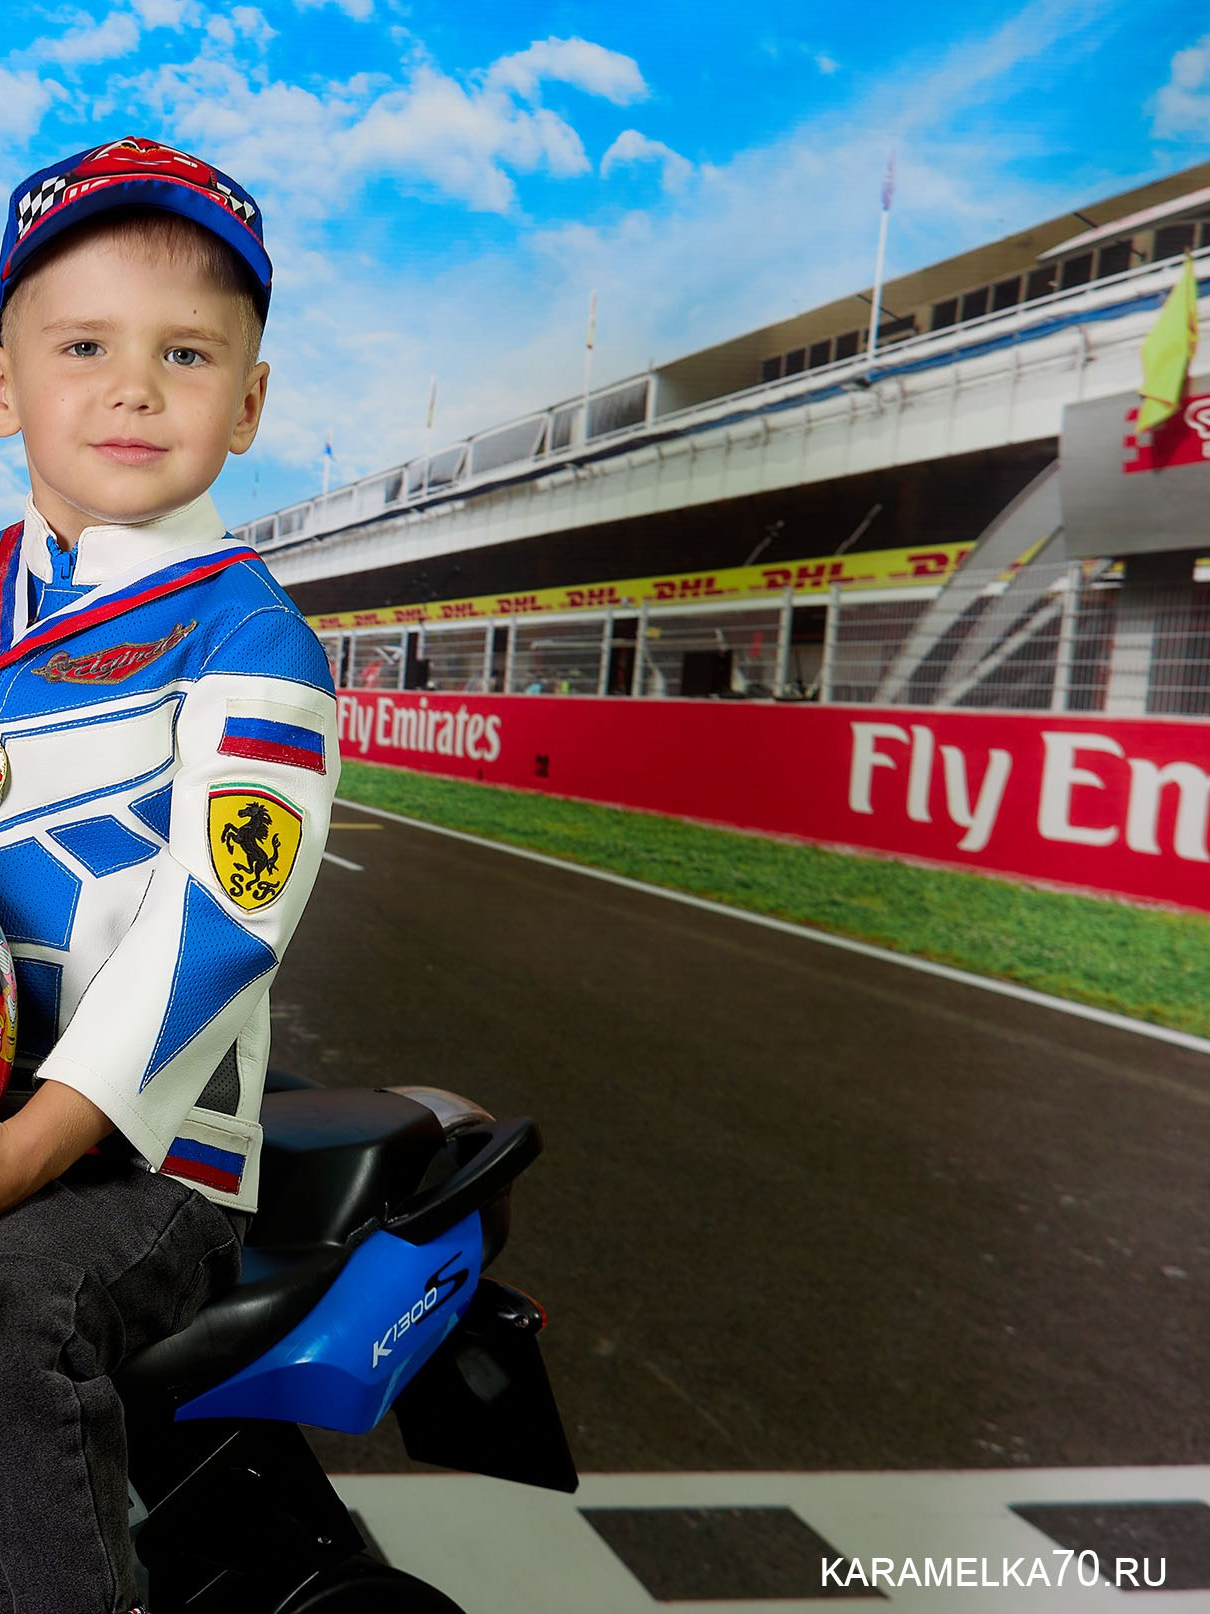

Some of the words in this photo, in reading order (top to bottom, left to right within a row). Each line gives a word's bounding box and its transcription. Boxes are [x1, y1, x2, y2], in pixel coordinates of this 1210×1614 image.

[653, 576, 724, 599] DHL
[762, 562, 855, 590] DHL
[497, 596, 543, 613] DHL
[566, 587, 622, 607] DHL
[440, 603, 480, 619] DHL
[338, 696, 374, 754] Fly
[375, 697, 502, 762] Emirates
[849, 721, 1013, 853] Fly
